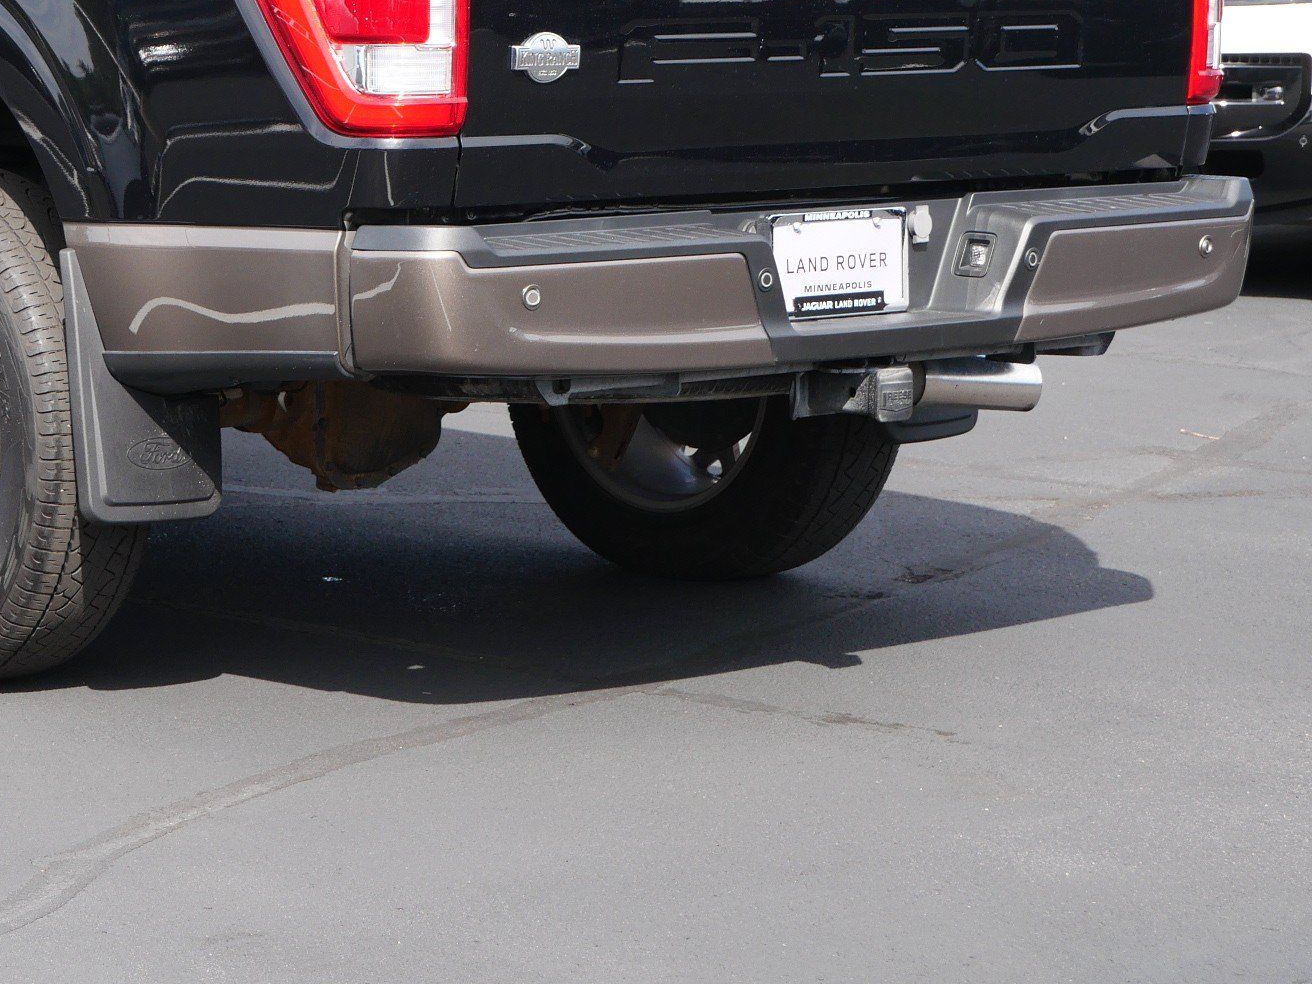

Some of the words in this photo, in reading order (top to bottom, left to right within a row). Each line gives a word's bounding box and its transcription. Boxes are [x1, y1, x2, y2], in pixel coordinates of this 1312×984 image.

[617, 11, 1084, 84] F-150
[804, 210, 871, 222] MINNEAPOLIS
[786, 256, 829, 274] LAND
[836, 252, 888, 271] ROVER
[803, 280, 872, 293] MINNEAPOLIS
[801, 300, 834, 312] JAGUAR
[834, 298, 853, 309] LAND
[854, 297, 877, 308] ROVER
[139, 442, 187, 465] Ford
